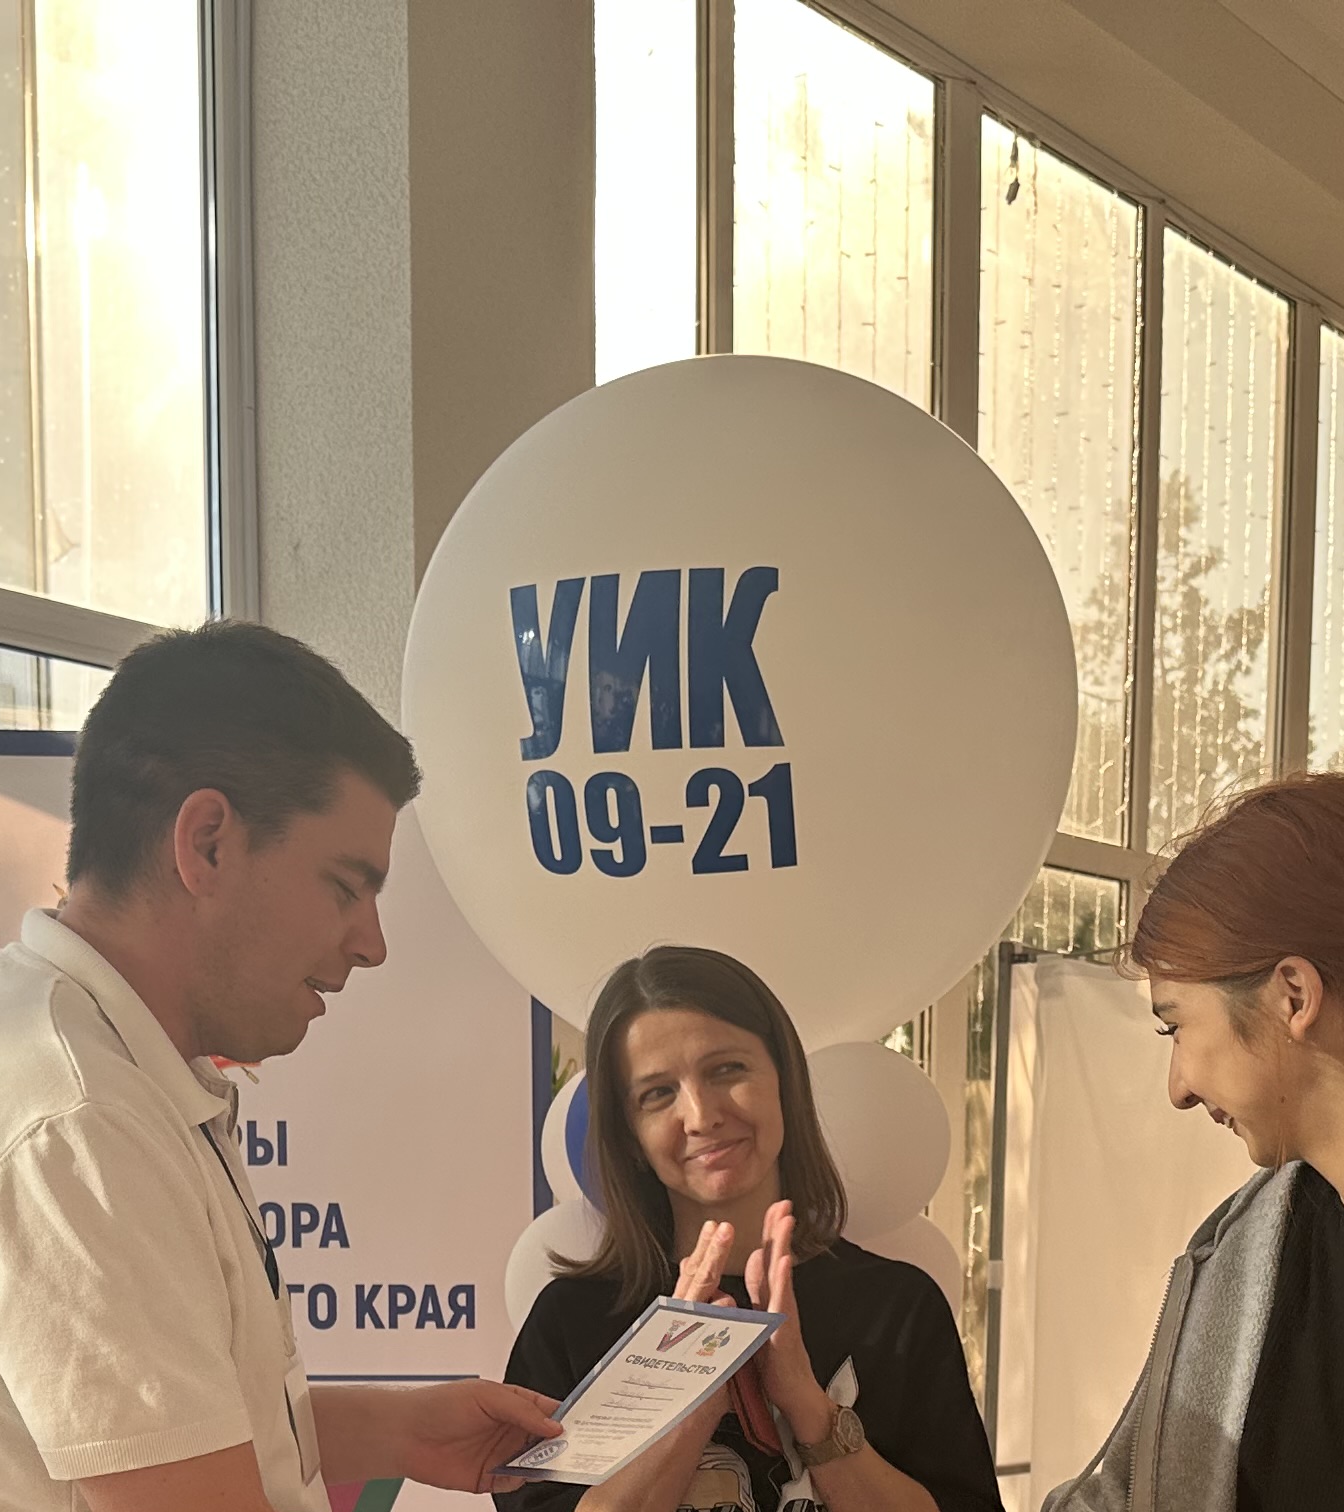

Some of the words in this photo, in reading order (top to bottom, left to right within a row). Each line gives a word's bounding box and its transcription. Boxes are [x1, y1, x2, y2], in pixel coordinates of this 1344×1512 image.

[510, 566, 784, 761] УИК
[526, 763, 797, 877] 09-21
[237, 1120, 287, 1166] Ы
[355, 1284, 476, 1330] КРАЯ
[625, 1354, 717, 1376] СВИДЕТЕЛЬСТВО
